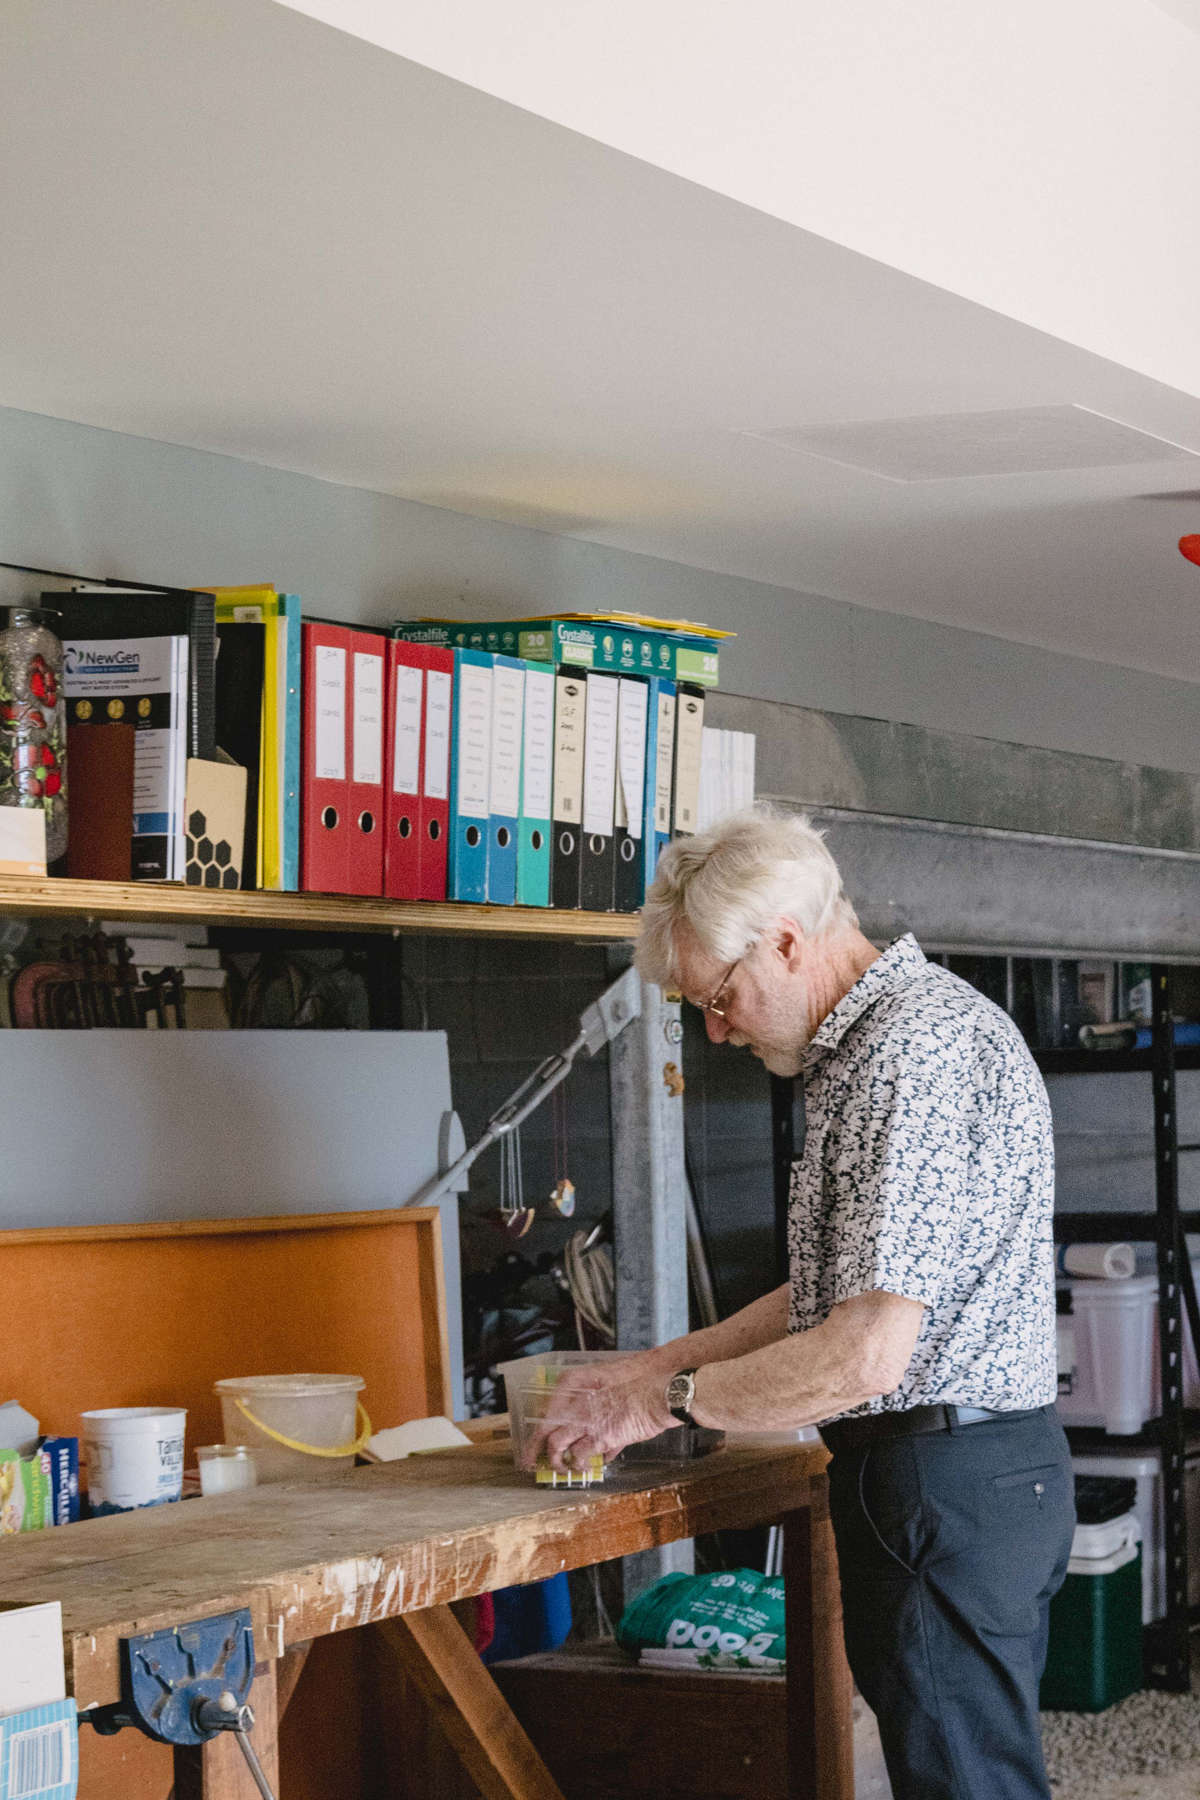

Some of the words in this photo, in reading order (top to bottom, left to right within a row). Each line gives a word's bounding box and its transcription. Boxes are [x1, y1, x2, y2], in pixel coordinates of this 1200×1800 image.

[395, 627, 448, 641] Crystalfile
[527, 634, 545, 646] 20
[558, 624, 595, 643] Crystalfile
[86, 651, 140, 664] NewGen
